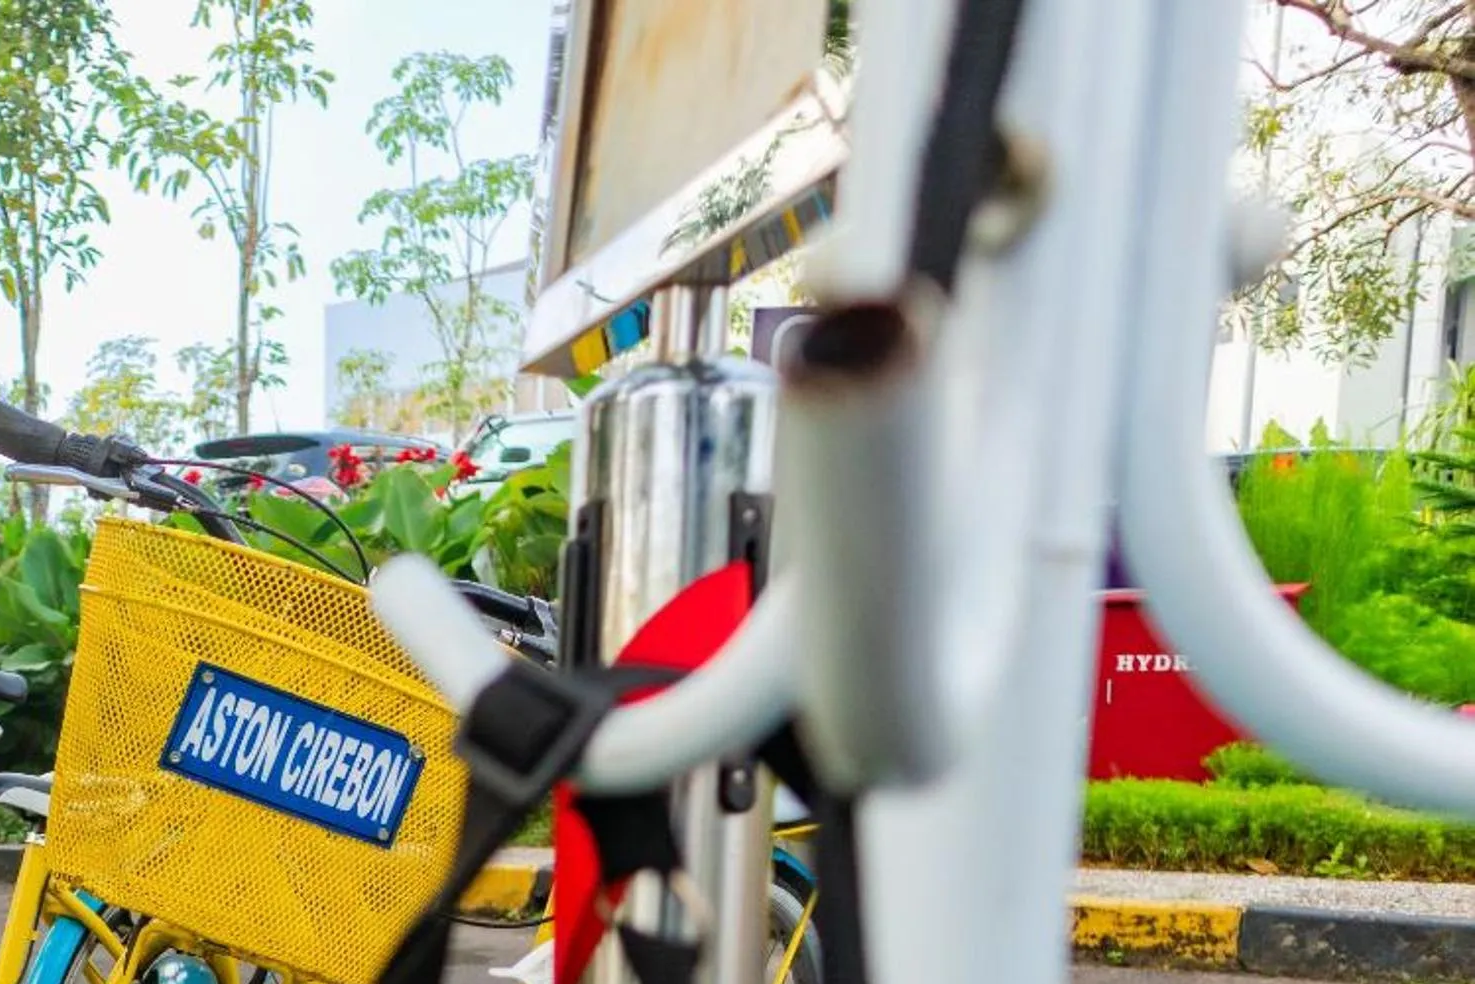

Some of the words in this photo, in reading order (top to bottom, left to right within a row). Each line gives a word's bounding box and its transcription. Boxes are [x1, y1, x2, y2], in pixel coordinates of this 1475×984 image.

[1116, 654, 1194, 672] HYDR
[180, 686, 293, 784] ASTON
[281, 722, 410, 824] CIREBON
